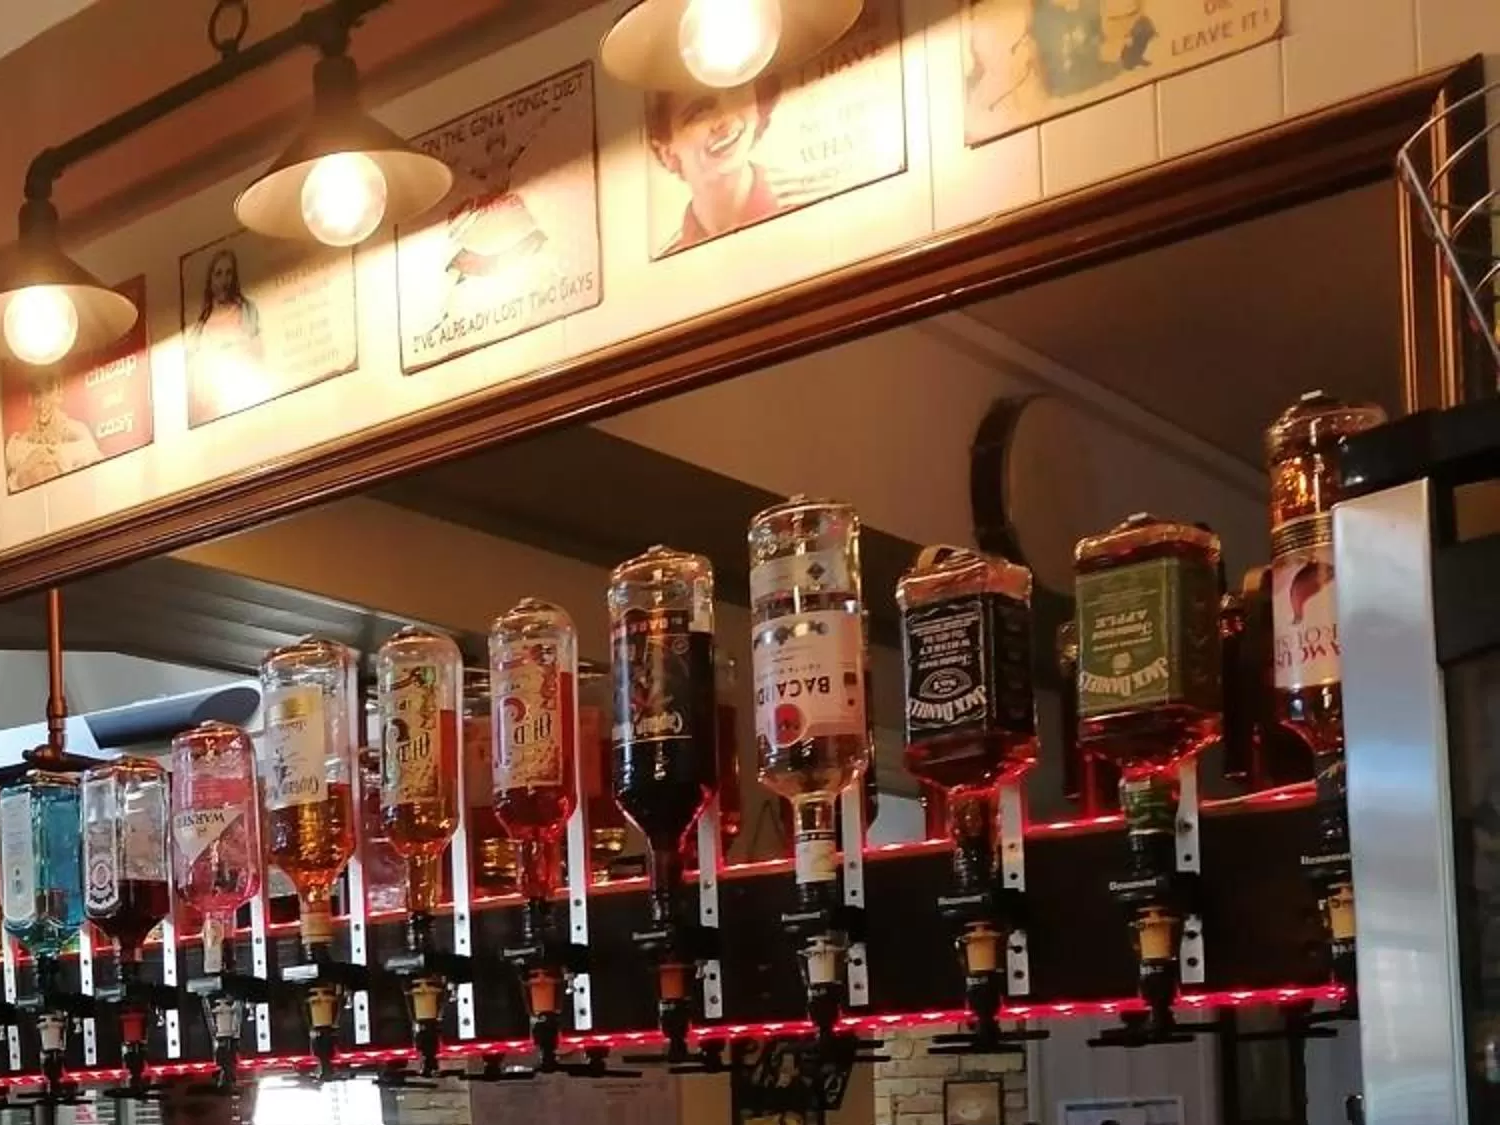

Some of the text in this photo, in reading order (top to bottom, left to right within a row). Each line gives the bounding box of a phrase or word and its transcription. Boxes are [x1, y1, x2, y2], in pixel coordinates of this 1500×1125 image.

[1171, 20, 1234, 57] LEAVE
[439, 308, 490, 346] ALREADY
[492, 297, 525, 325] LOST
[1132, 657, 1169, 690] JACK
